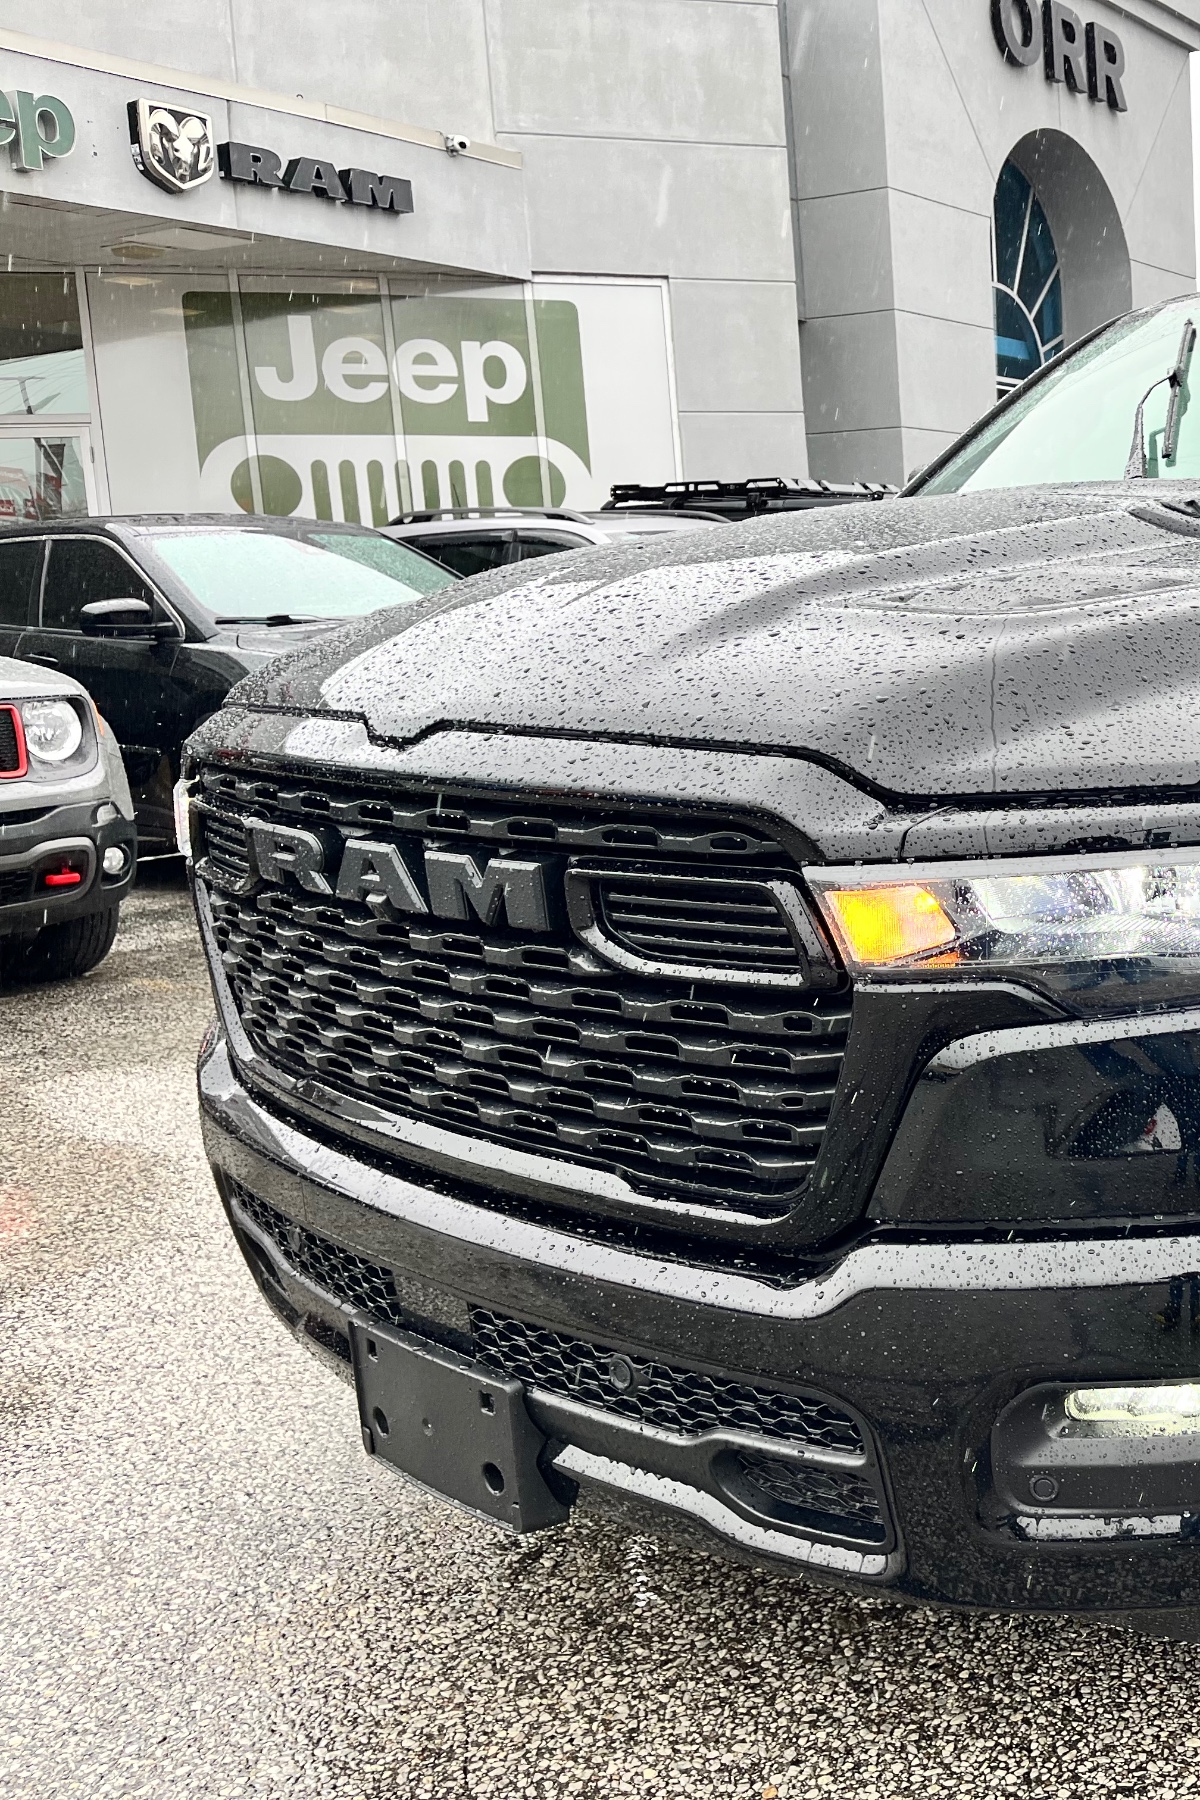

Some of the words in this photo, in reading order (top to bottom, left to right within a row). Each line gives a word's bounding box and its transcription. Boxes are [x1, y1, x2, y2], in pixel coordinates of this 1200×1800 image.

[991, 0, 1128, 112] ORR
[217, 141, 415, 214] RAM
[255, 315, 528, 423] Jeep
[245, 816, 551, 932] RAM
